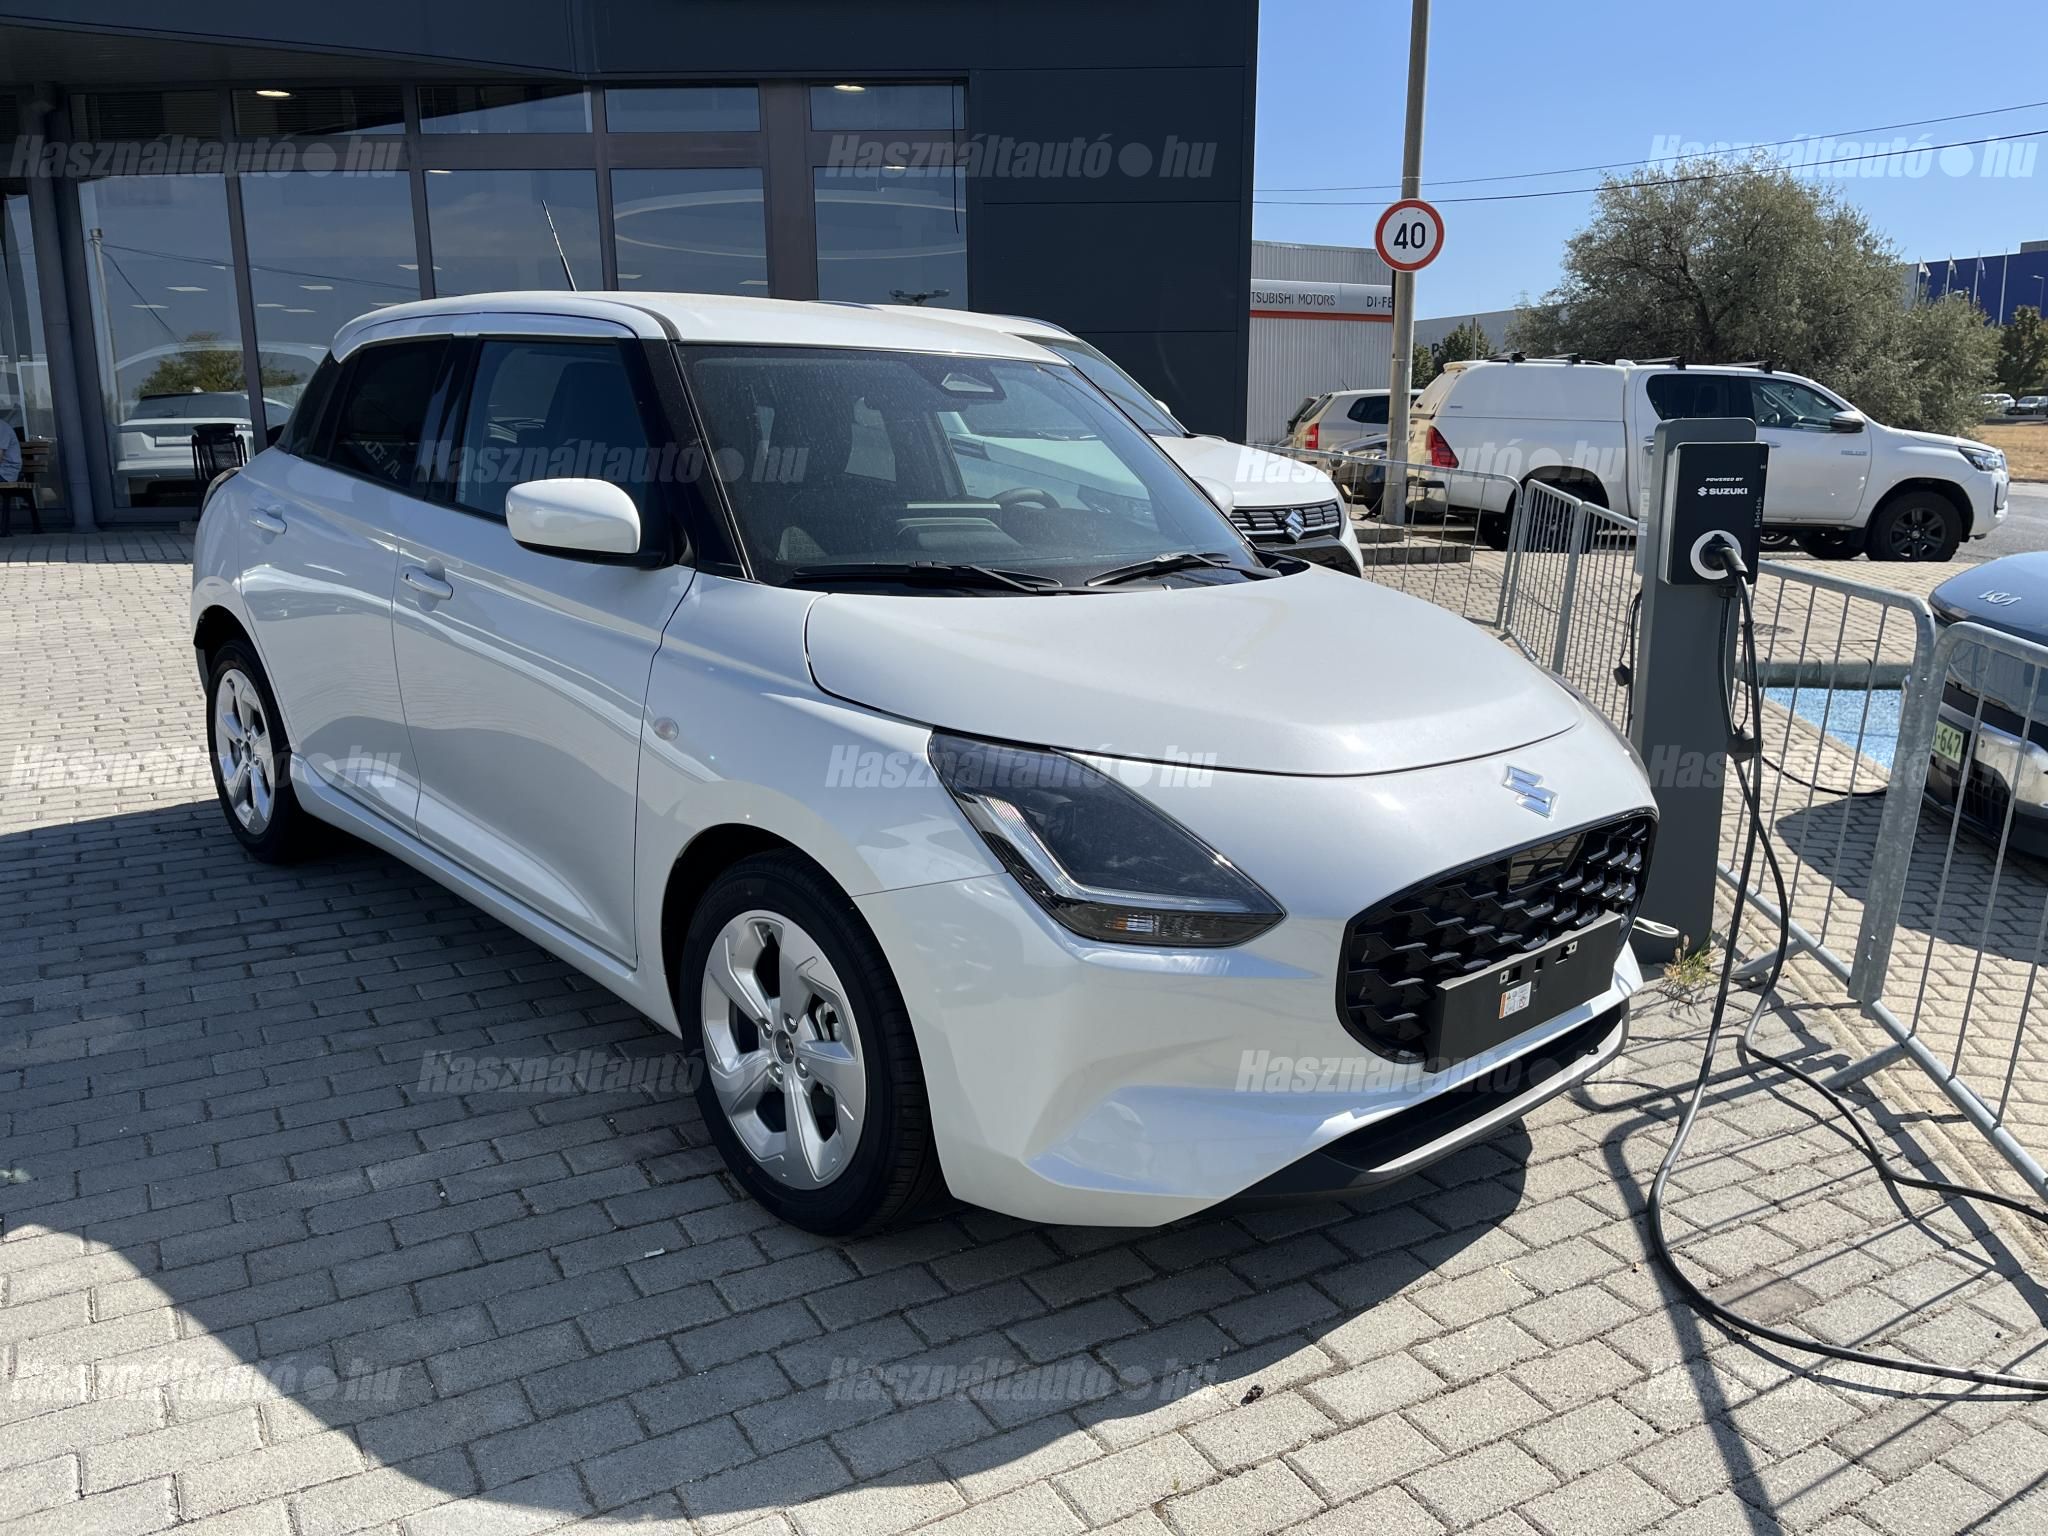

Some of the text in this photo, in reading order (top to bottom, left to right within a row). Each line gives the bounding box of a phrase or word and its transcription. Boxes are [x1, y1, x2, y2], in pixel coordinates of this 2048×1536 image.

[1393, 222, 1426, 249] 40
[1298, 293, 1336, 306] MOTORS
[1708, 487, 1748, 495] SUZUKI
